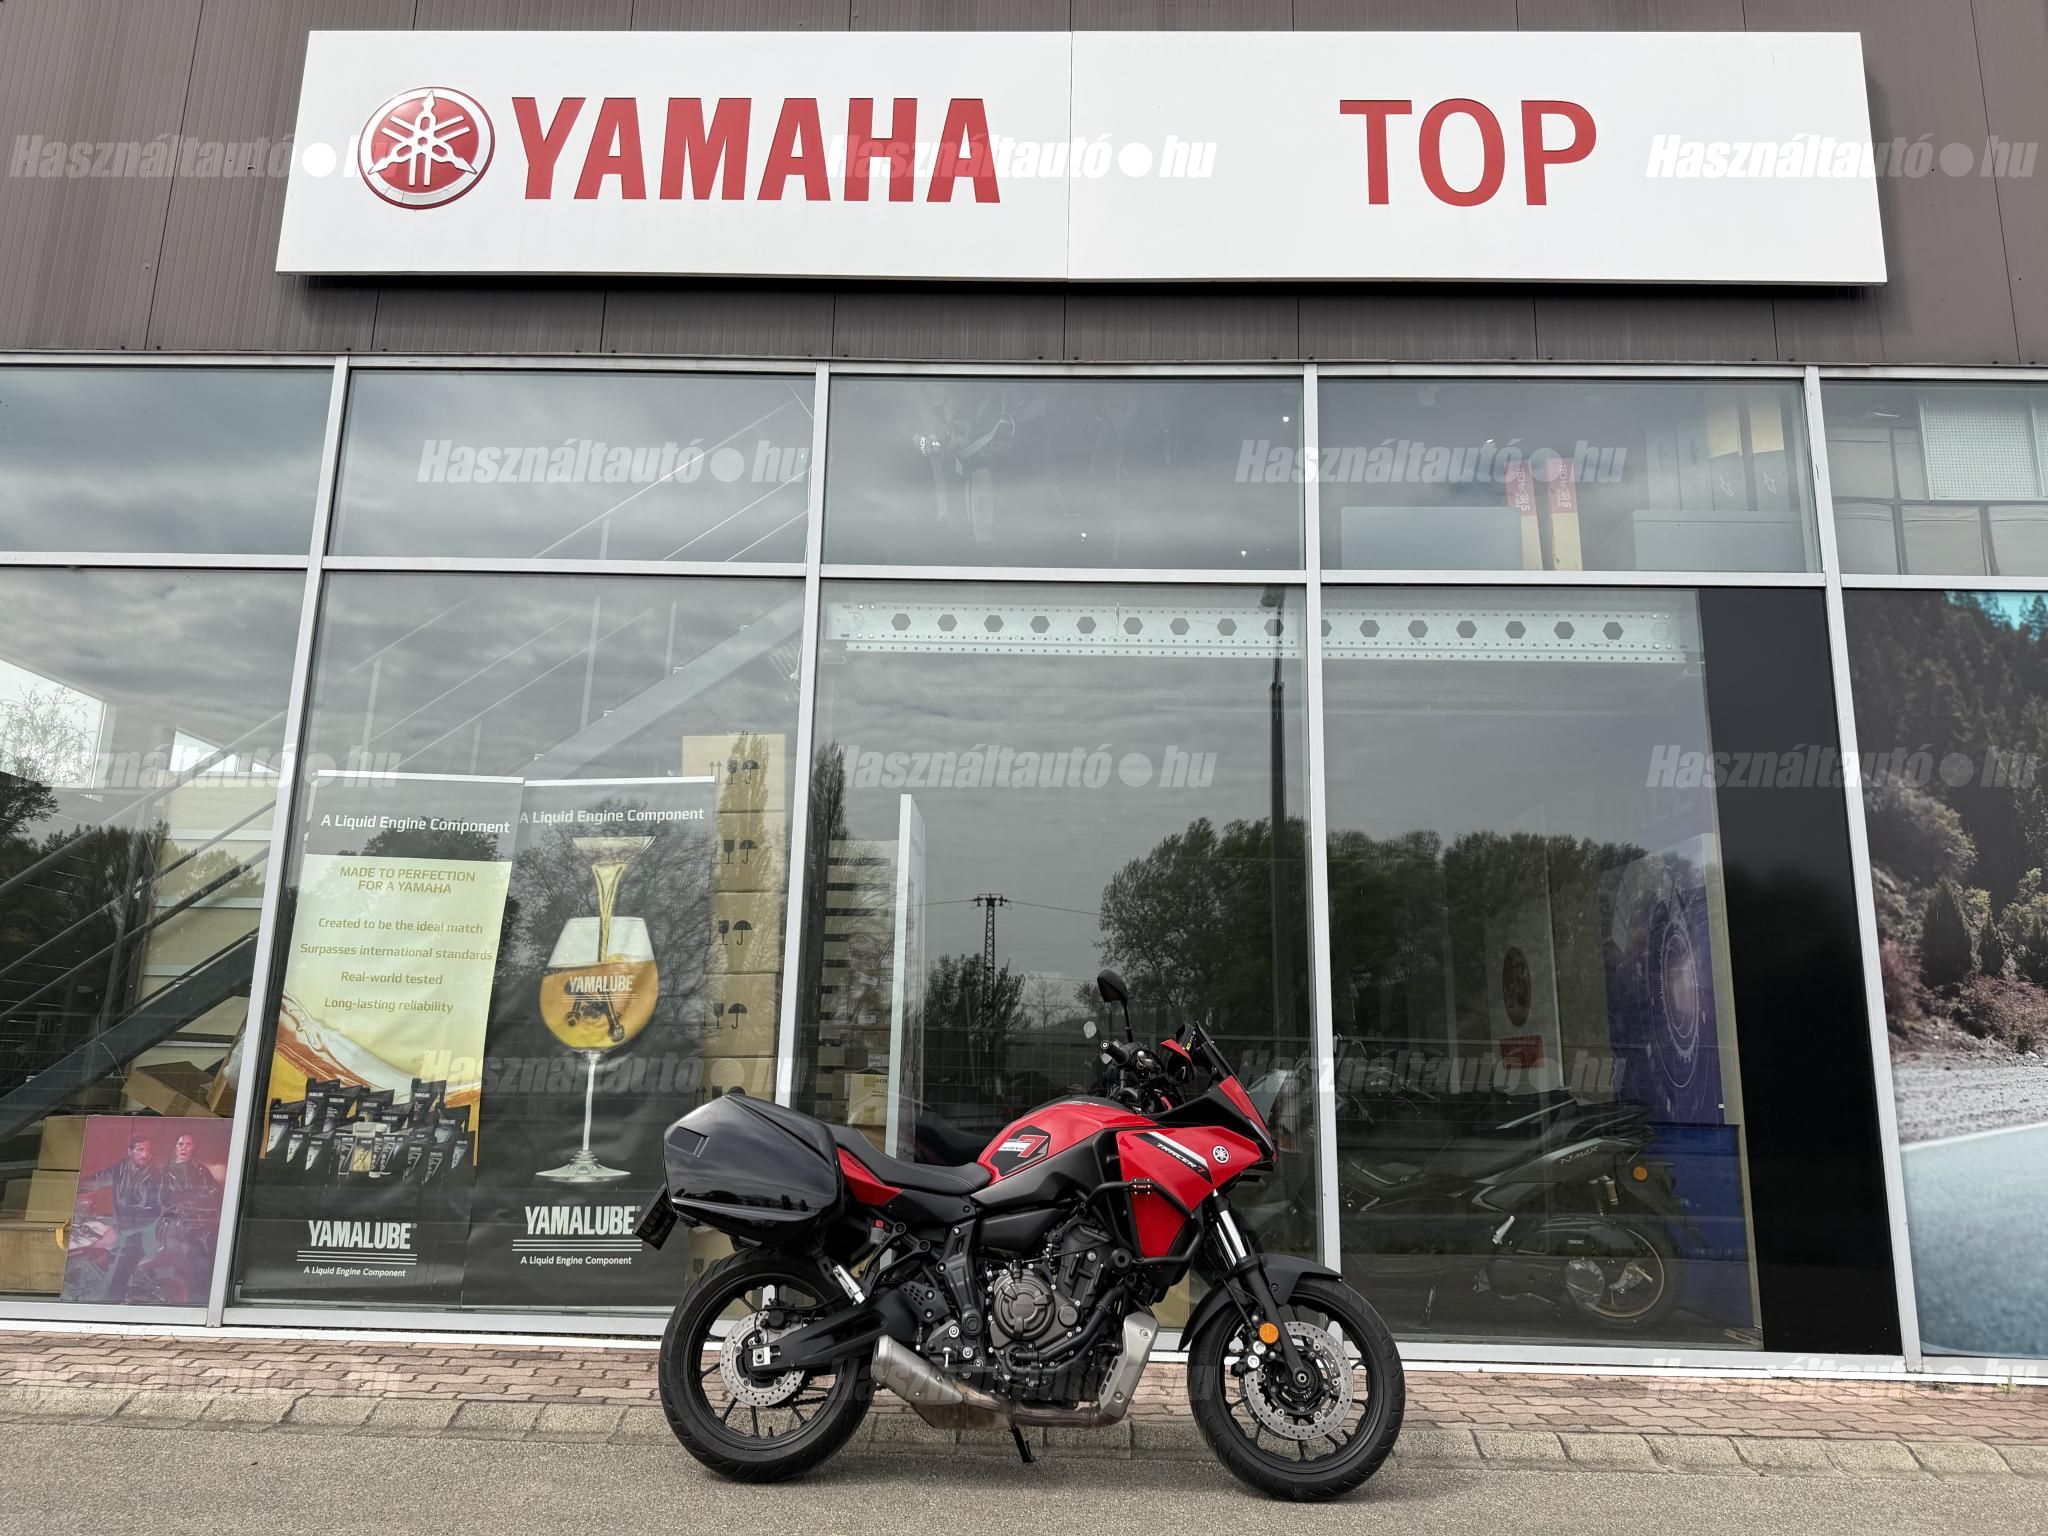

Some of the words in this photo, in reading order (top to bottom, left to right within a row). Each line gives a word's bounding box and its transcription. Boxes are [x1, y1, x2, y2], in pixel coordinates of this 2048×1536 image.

[512, 97, 1000, 203] YAMAHA
[1340, 98, 1597, 206] TOP
[321, 814, 331, 826] A
[335, 815, 376, 830] Liquid
[380, 816, 426, 832] Engine
[430, 818, 510, 834] Component
[520, 812, 529, 824] A
[532, 810, 574, 826] Liquid
[577, 810, 624, 825] Engine
[627, 808, 705, 824] Component
[340, 867, 374, 878] MADE
[380, 868, 395, 878] TO
[398, 869, 475, 882] PERFECTION
[358, 880, 383, 891] FOR
[386, 881, 394, 891] A
[398, 882, 451, 894] YAMAHA
[318, 918, 360, 929] Created
[364, 920, 375, 929] to
[378, 920, 392, 930] be
[395, 921, 413, 931] the
[416, 921, 443, 932] ideal
[446, 923, 483, 934] match
[300, 943, 357, 956] Surpasses
[359, 945, 432, 958] international
[435, 949, 492, 961] standards
[341, 972, 402, 984] Real-world
[405, 974, 443, 985] tested
[569, 975, 635, 992] YAMALUBE
[324, 997, 396, 1012] Long-lasting
[398, 999, 454, 1014] reliability
[1157, 1143, 1197, 1168] TRACER
[525, 1205, 635, 1235] YAMALUBE
[308, 1220, 411, 1250] YAMALUBE
[520, 1256, 527, 1265] A
[529, 1256, 554, 1267] Liquid
[556, 1256, 583, 1267] Engine
[585, 1256, 632, 1267] Component
[304, 1266, 310, 1274] A
[312, 1266, 335, 1276] Liquid
[336, 1267, 360, 1277] Engine
[363, 1268, 406, 1278] Component
